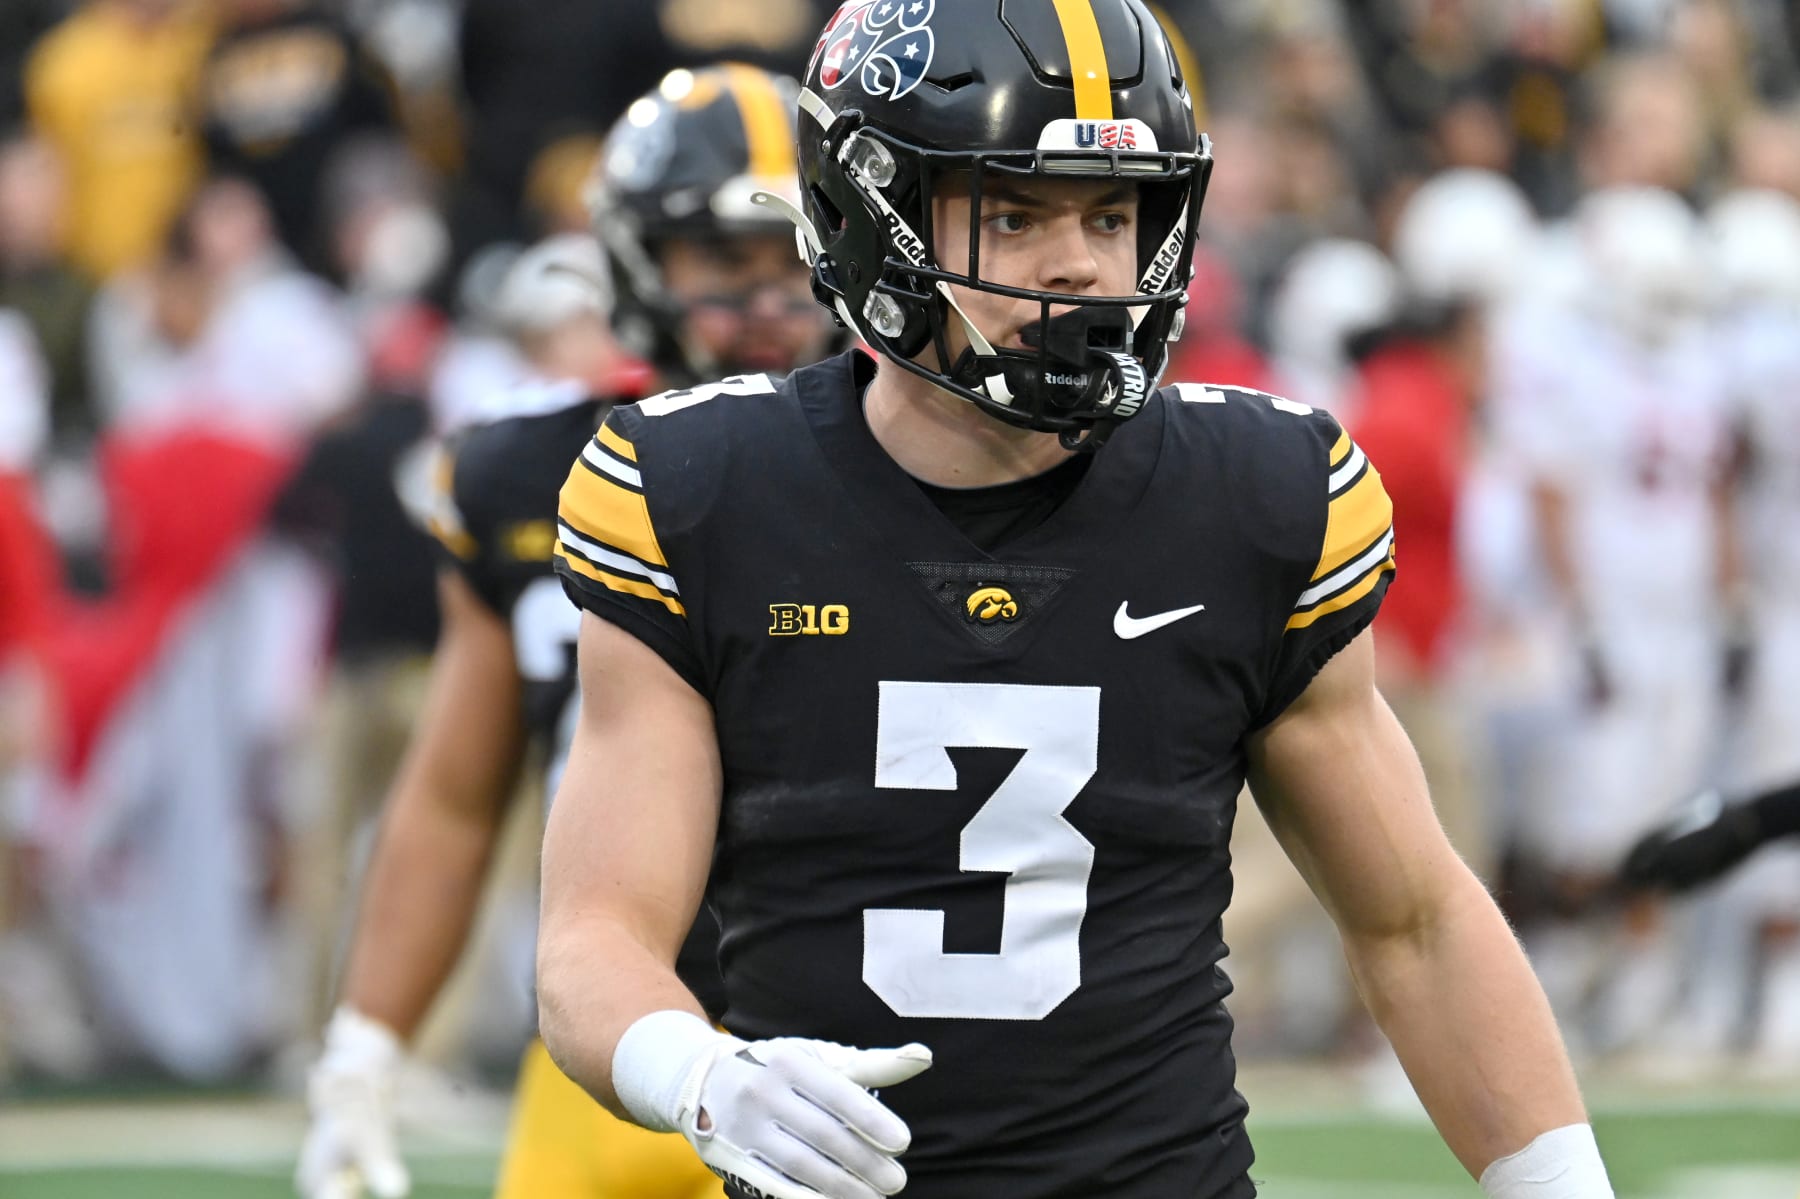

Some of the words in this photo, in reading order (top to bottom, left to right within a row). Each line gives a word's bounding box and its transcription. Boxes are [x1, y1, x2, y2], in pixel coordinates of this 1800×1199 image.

[1075, 123, 1137, 149] USA
[1138, 227, 1185, 295] Riddell
[1044, 372, 1088, 387] Riddell
[862, 680, 1102, 1020] 3
